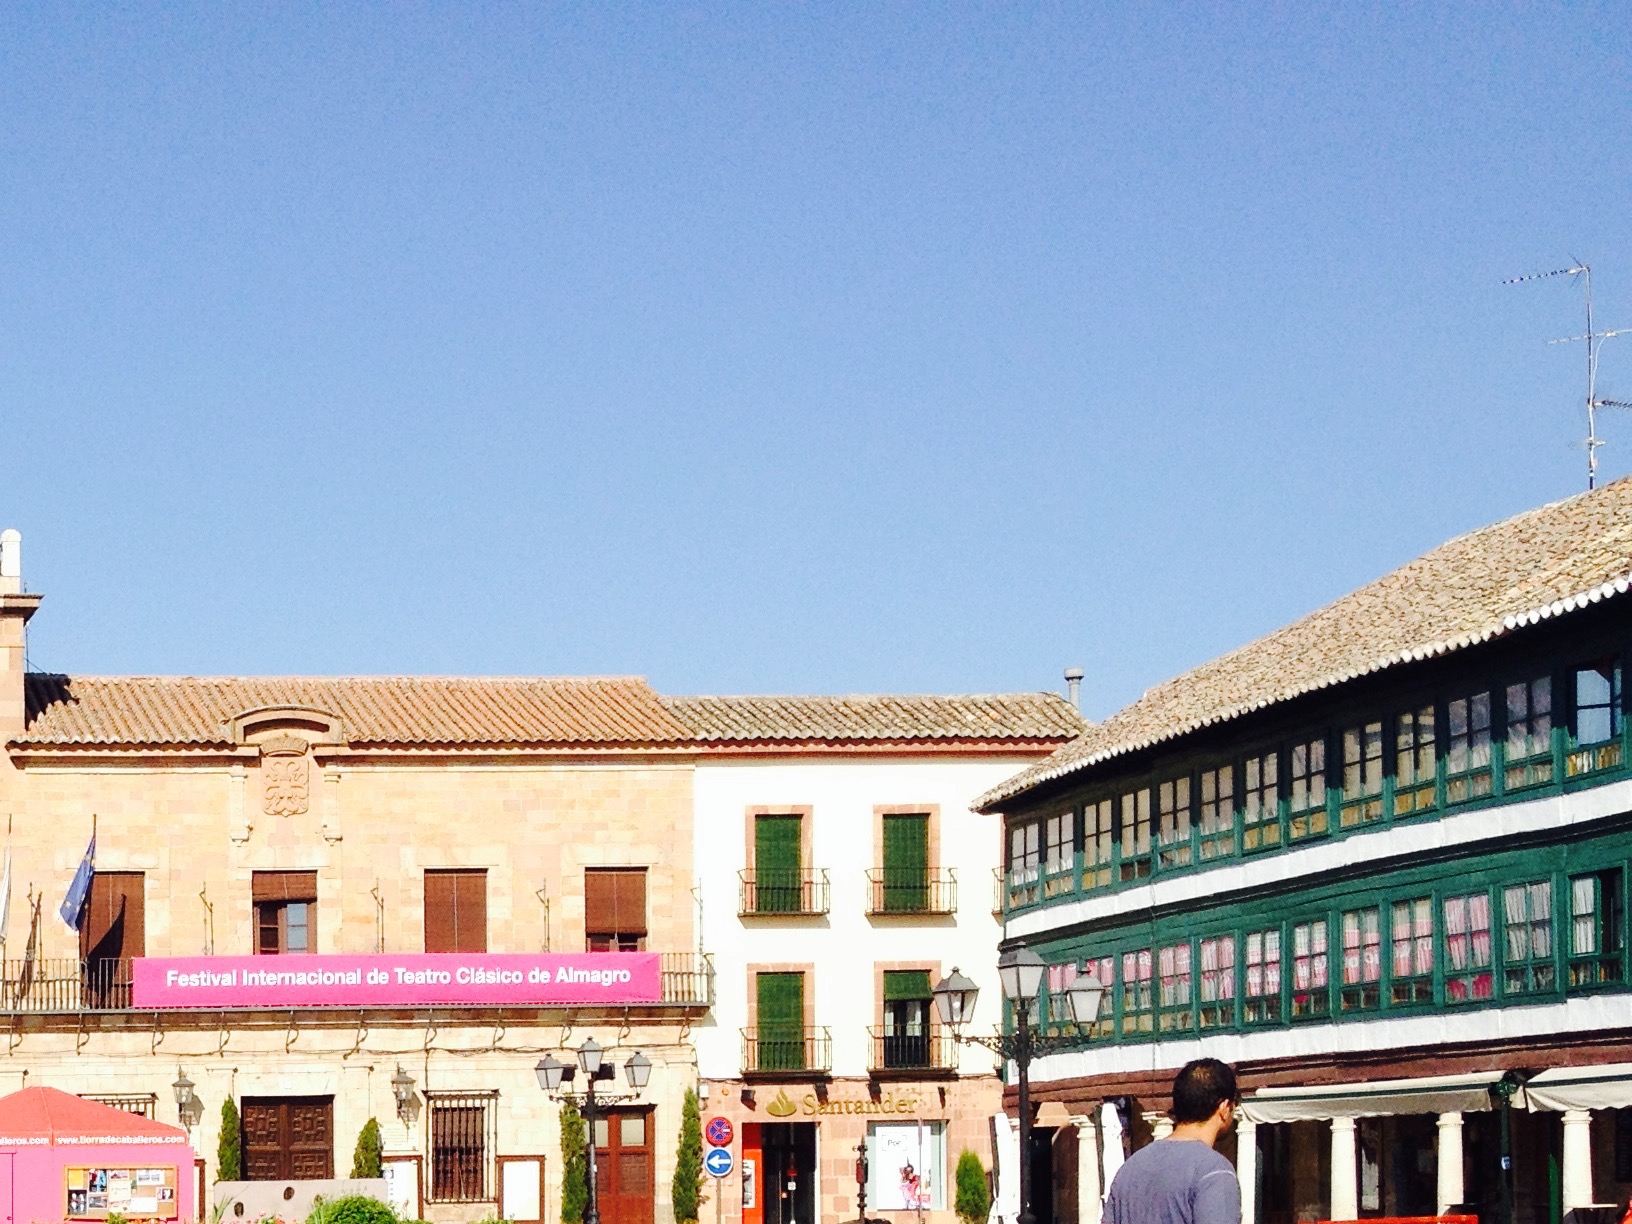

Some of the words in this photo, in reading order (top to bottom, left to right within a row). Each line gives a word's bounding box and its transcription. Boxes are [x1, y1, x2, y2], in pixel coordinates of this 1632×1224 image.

[167, 969, 237, 987] Festival
[242, 968, 362, 987] Internacional
[366, 968, 389, 985] de
[394, 967, 451, 984] Teatro
[456, 967, 523, 984] Clásico
[527, 967, 551, 983] de
[555, 966, 631, 986] Almagro
[802, 1093, 918, 1115] Santander
